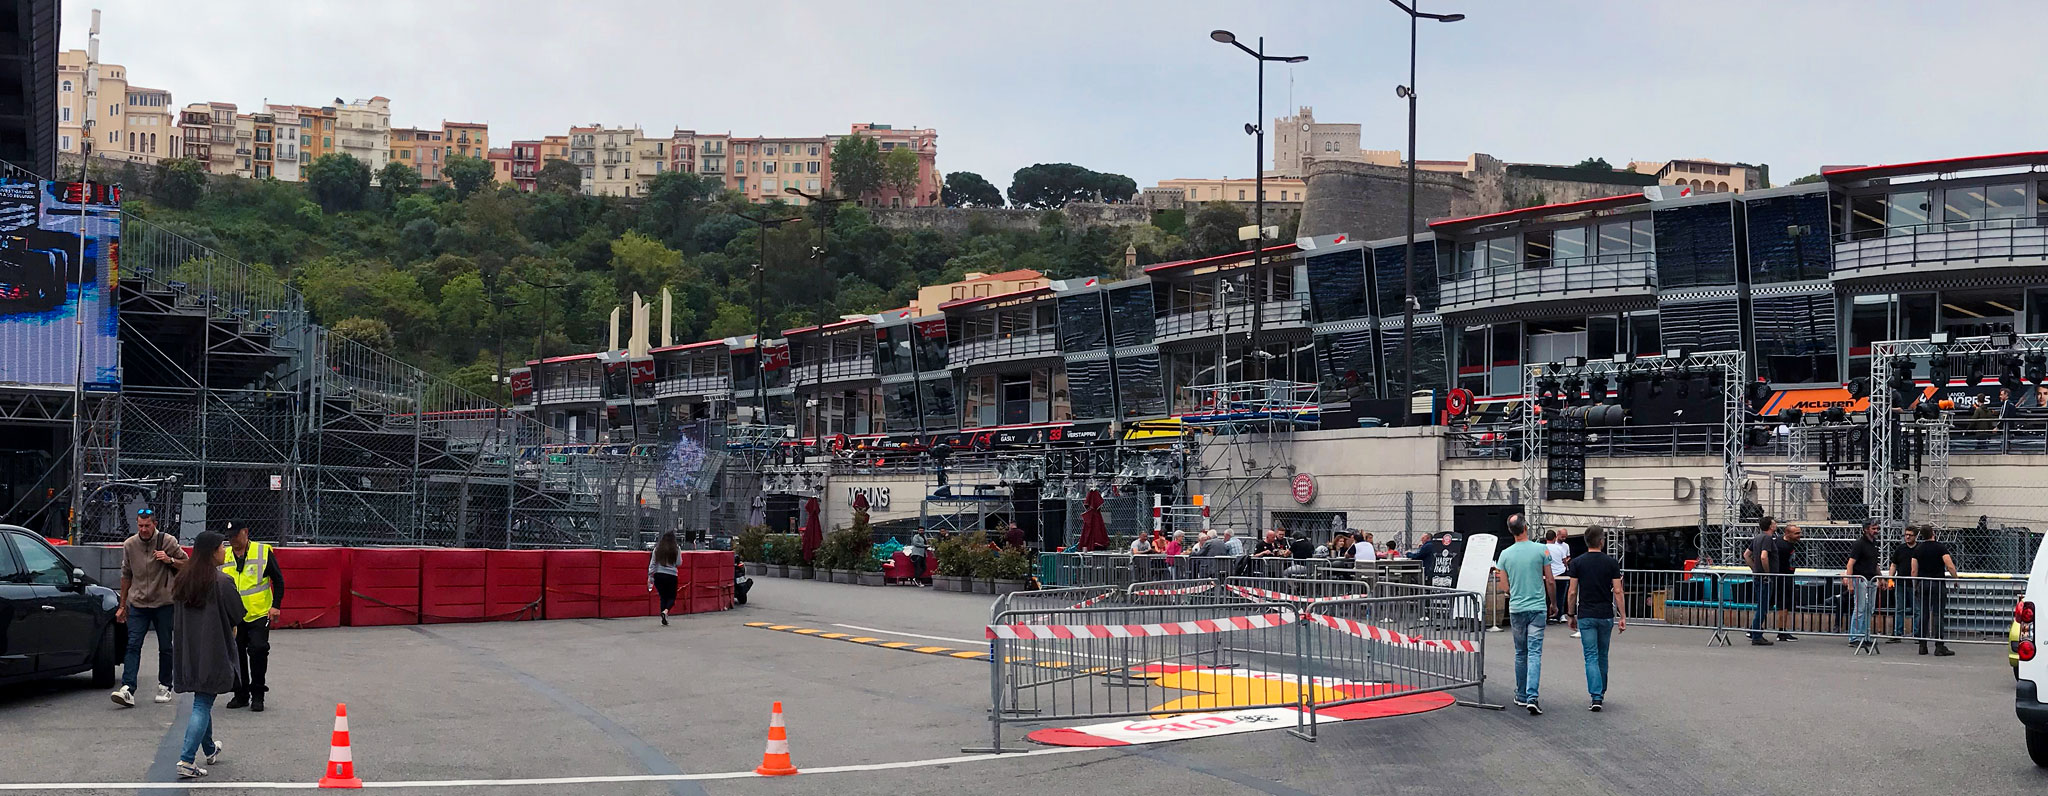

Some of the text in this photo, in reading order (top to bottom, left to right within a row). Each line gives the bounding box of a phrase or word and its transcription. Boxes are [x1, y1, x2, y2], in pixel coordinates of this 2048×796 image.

[1948, 395, 1991, 405] NORRS
[1792, 401, 1854, 409] McLaren
[1435, 557, 1452, 566] HAPPY
